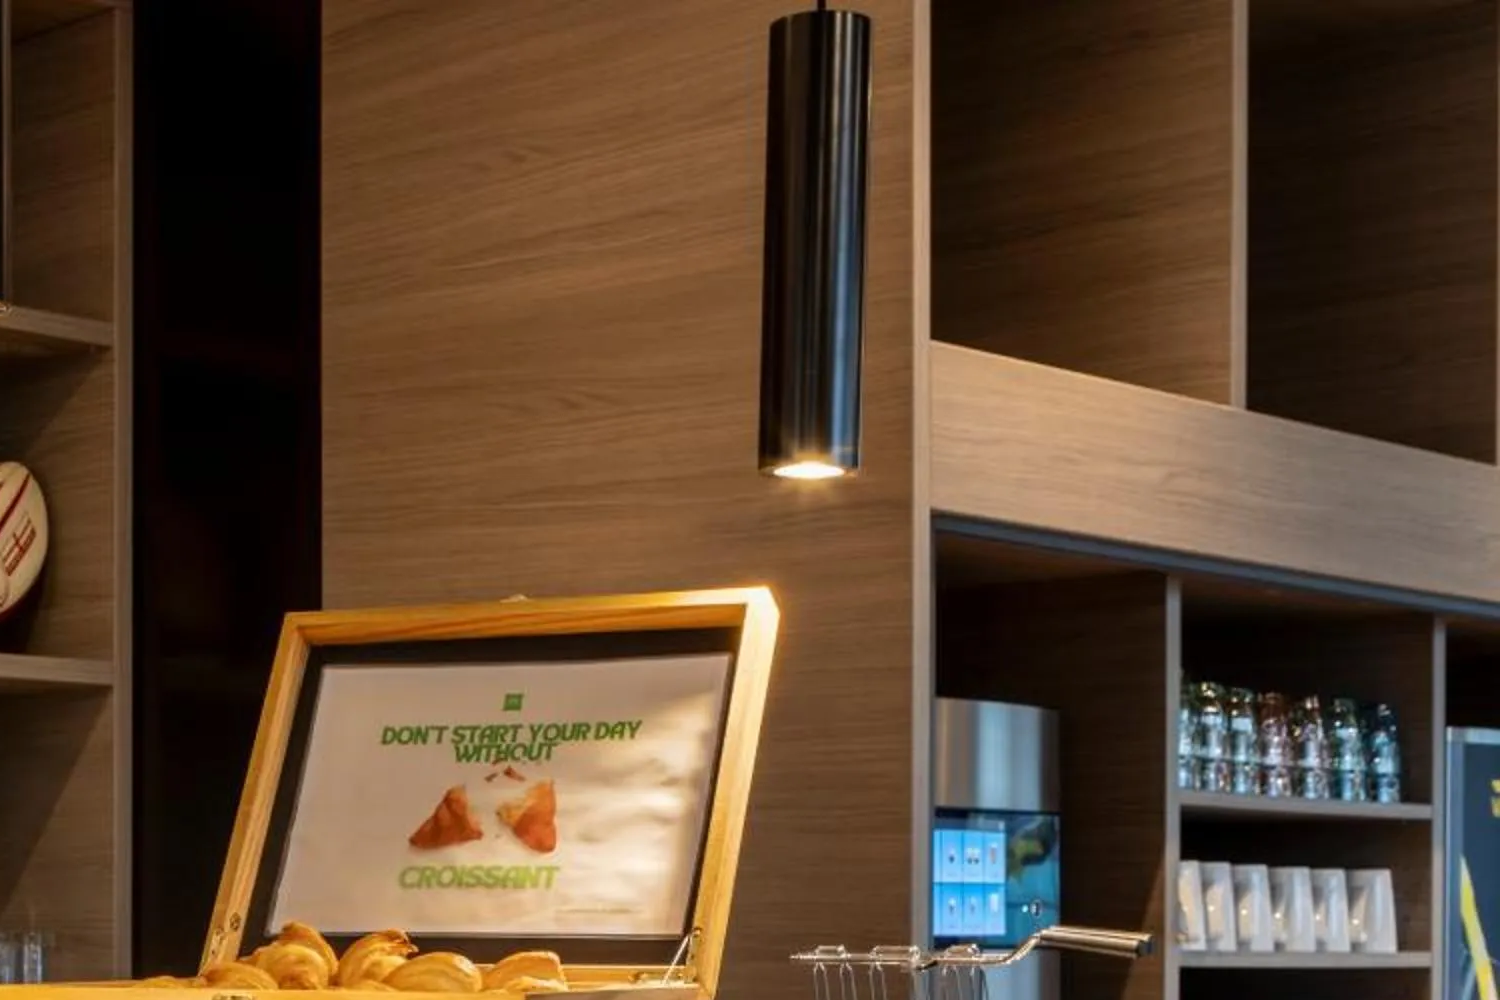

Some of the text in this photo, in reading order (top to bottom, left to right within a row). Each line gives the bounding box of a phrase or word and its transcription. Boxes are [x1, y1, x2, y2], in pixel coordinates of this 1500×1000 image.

[381, 719, 642, 745] DON'T START YOUR DAY
[454, 742, 560, 764] WITHOUT
[398, 864, 560, 891] CROISSANT
